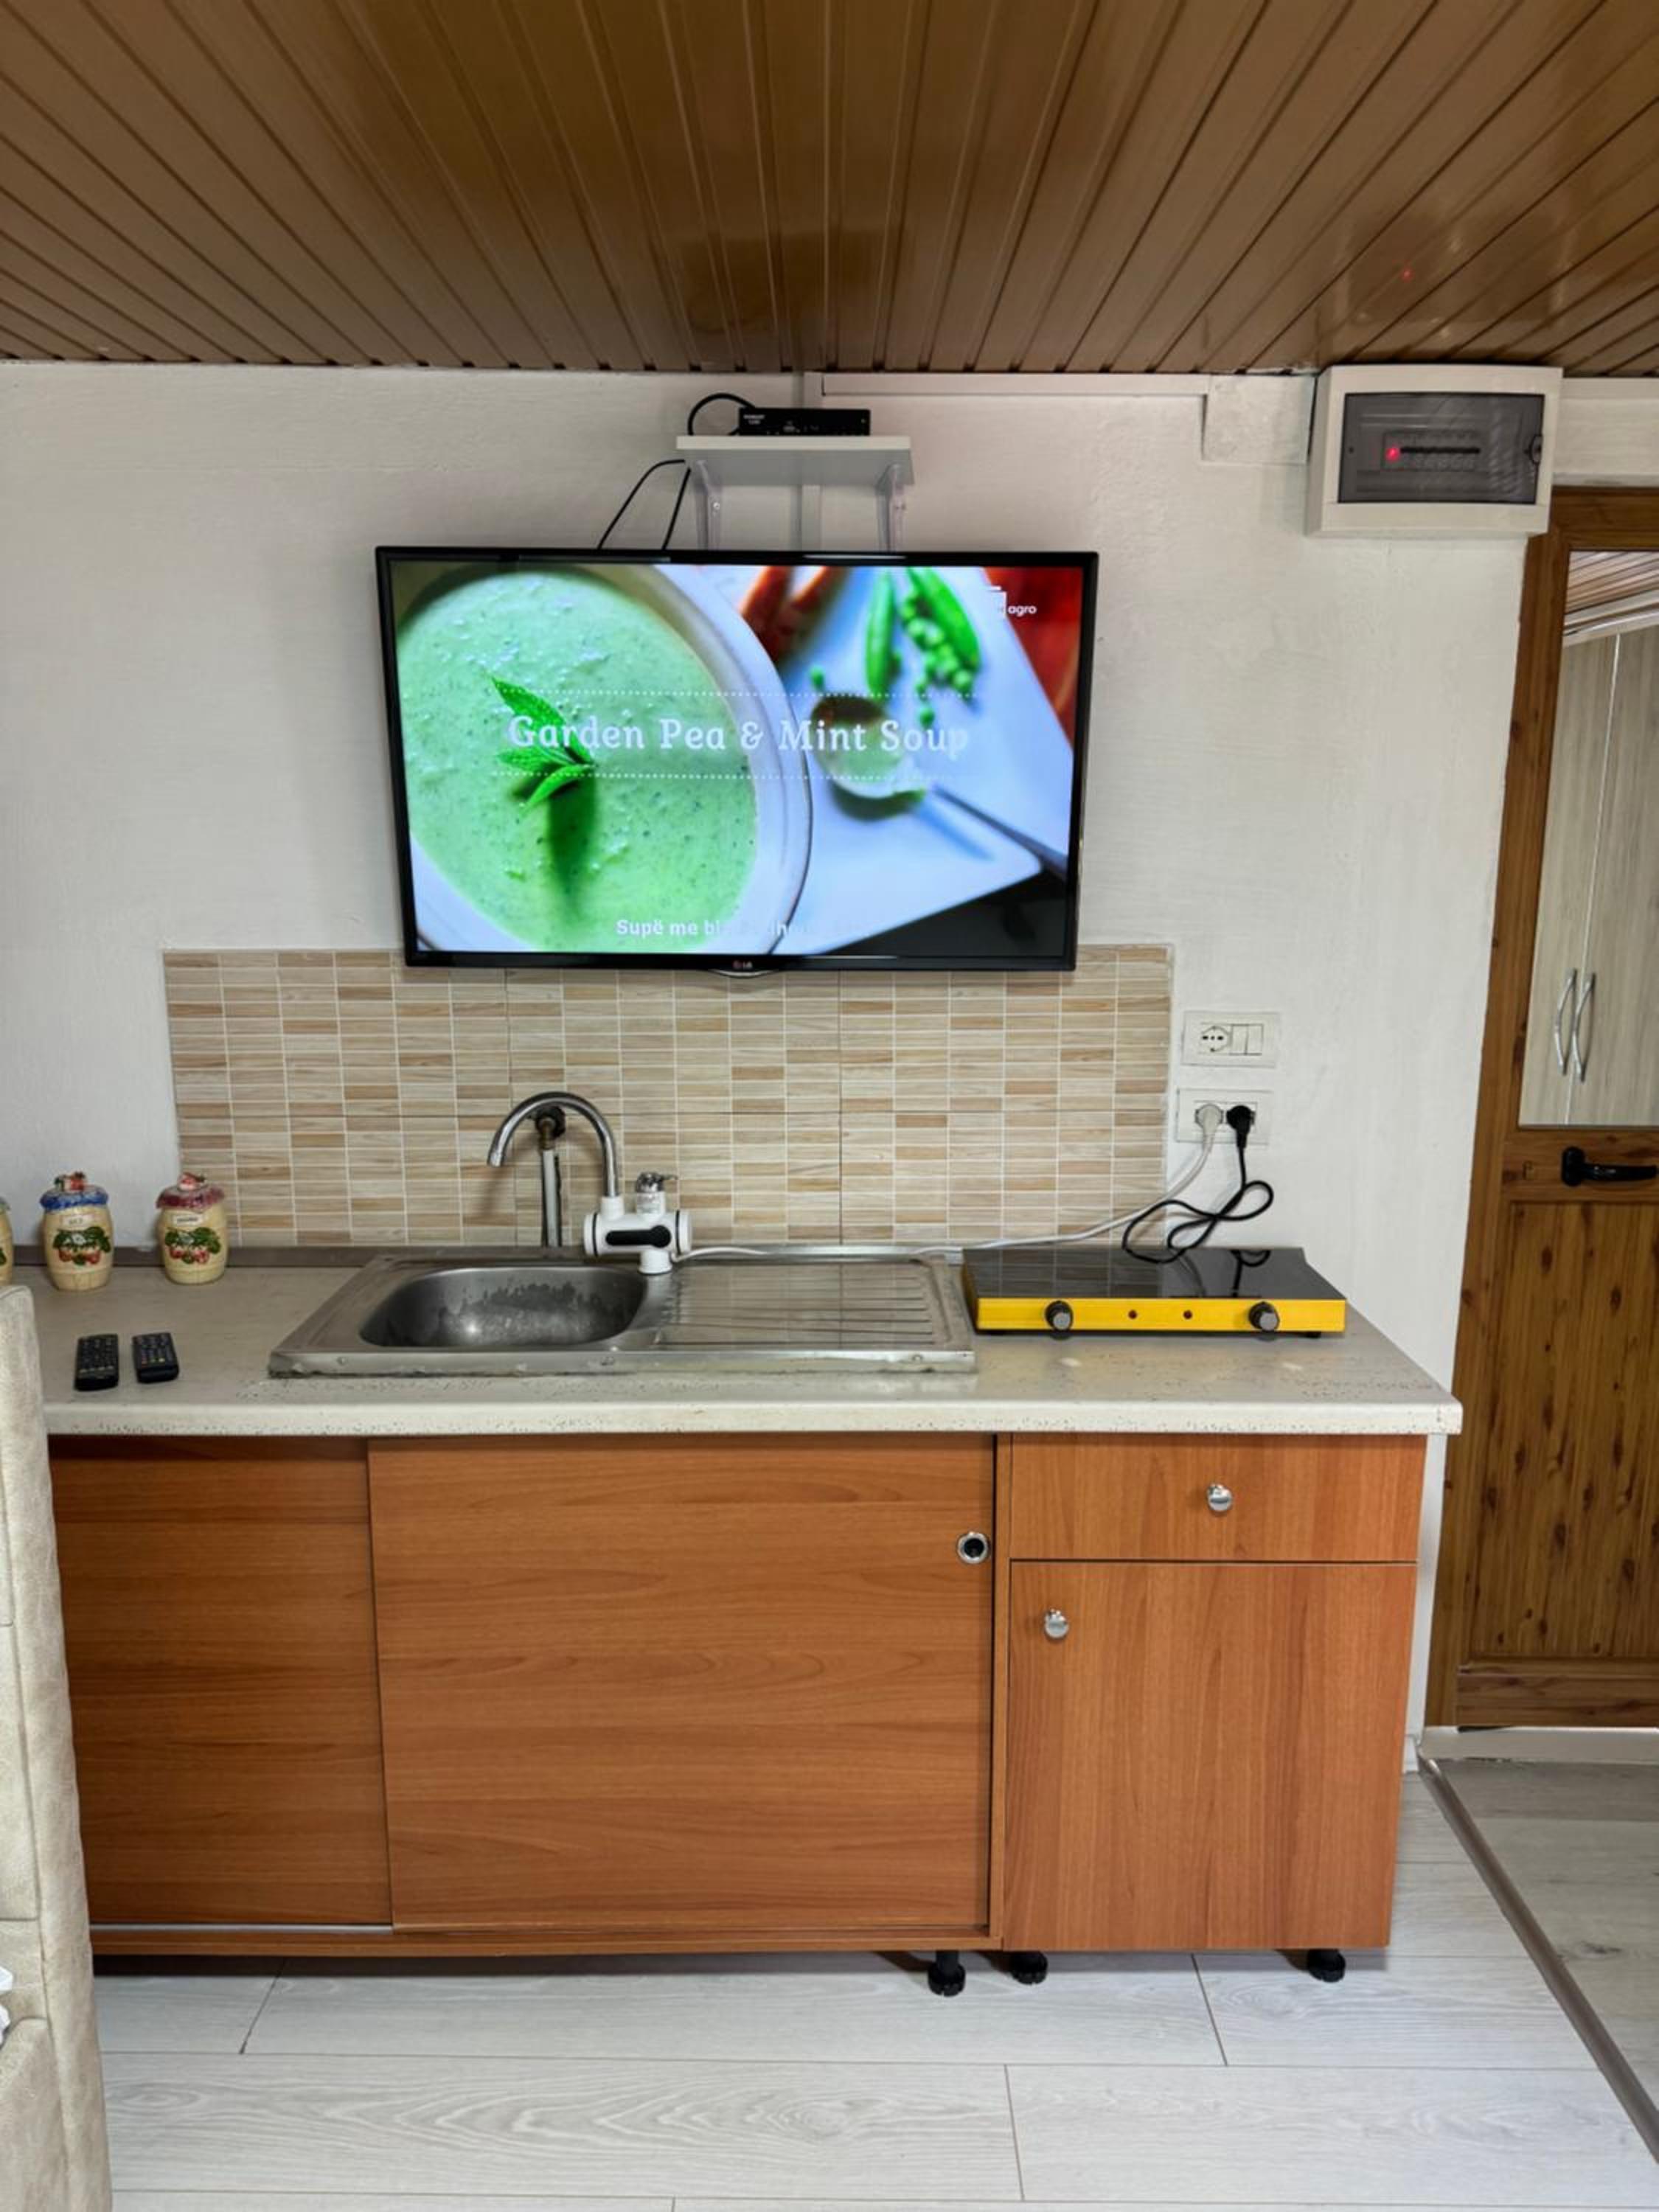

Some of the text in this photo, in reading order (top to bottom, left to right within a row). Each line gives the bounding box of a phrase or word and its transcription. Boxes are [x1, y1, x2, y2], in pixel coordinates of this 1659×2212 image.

[1007, 605, 1037, 617] agro
[507, 715, 970, 761] Garden Pea & Mint Soup
[616, 919, 663, 939] Supë
[669, 922, 698, 936] me
